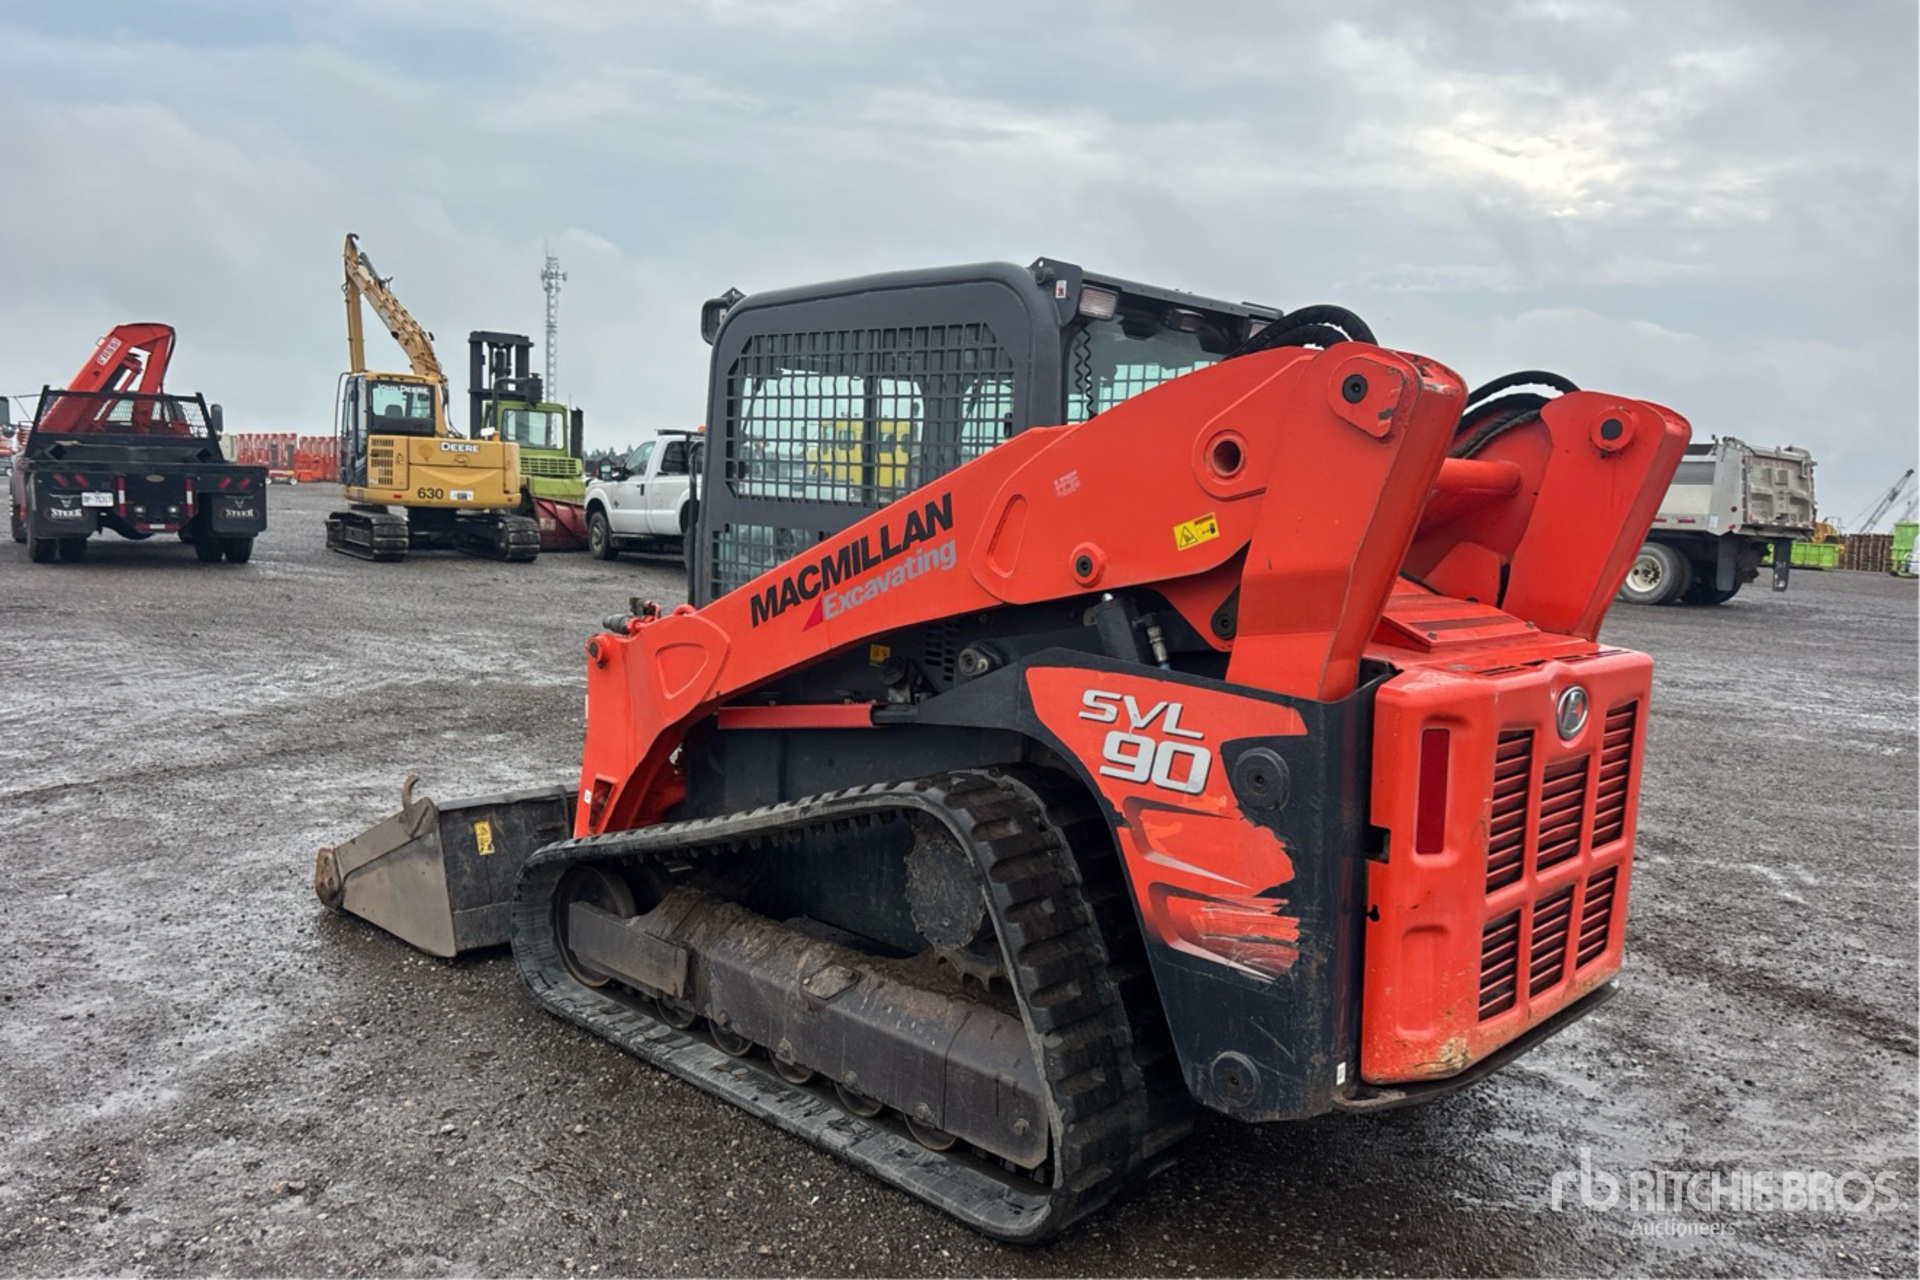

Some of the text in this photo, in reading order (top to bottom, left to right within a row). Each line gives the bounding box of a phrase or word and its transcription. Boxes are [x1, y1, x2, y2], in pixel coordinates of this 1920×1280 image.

[97, 338, 121, 365] FASSI
[441, 442, 479, 452] DEERE
[417, 487, 444, 499] 630
[750, 492, 953, 627] MACMILLAN
[822, 539, 956, 621] Excavating
[1078, 689, 1205, 740] SVL
[1099, 730, 1212, 796] 90
